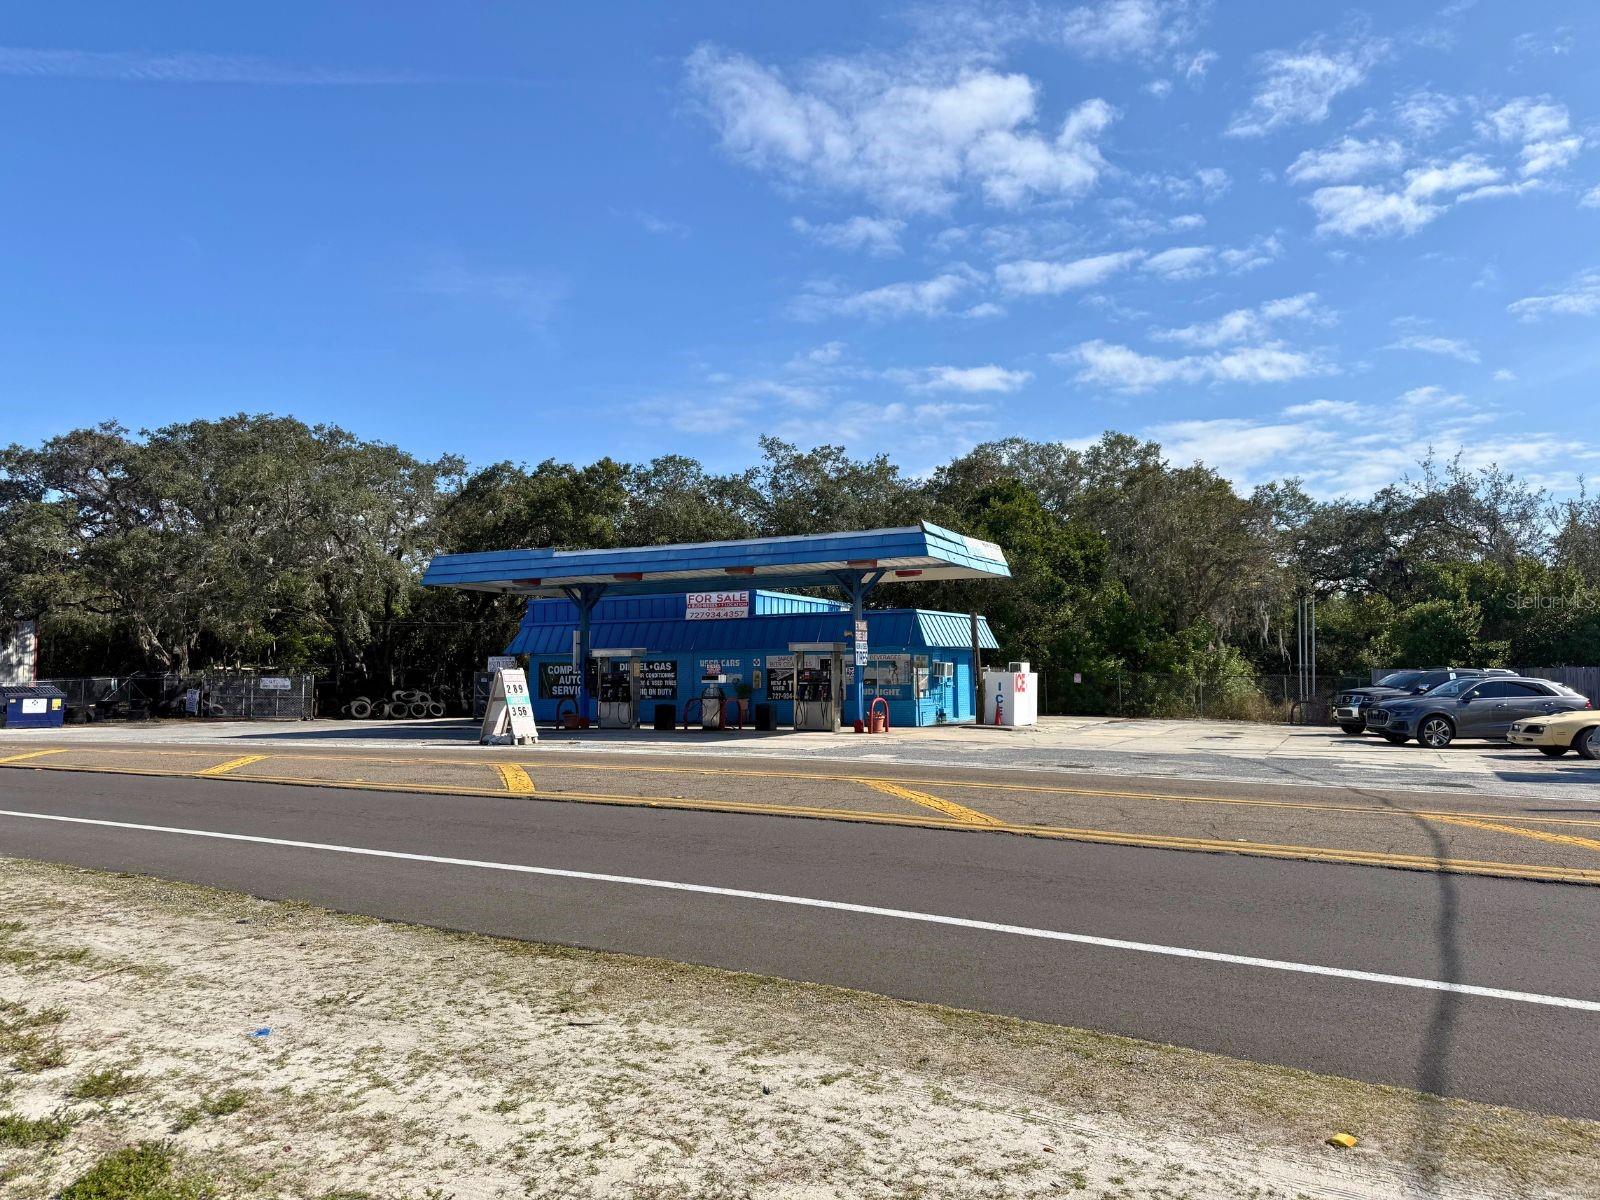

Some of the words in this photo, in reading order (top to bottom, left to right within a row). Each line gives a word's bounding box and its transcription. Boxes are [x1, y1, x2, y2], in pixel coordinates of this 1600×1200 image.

[688, 594, 712, 603] FOR
[716, 592, 747, 602] SALE
[619, 662, 650, 671] DIEL
[721, 659, 740, 667] CARS
[547, 665, 582, 675] COMPL
[648, 688, 657, 696] ON
[657, 688, 672, 696] DUTY
[863, 688, 874, 696] UD
